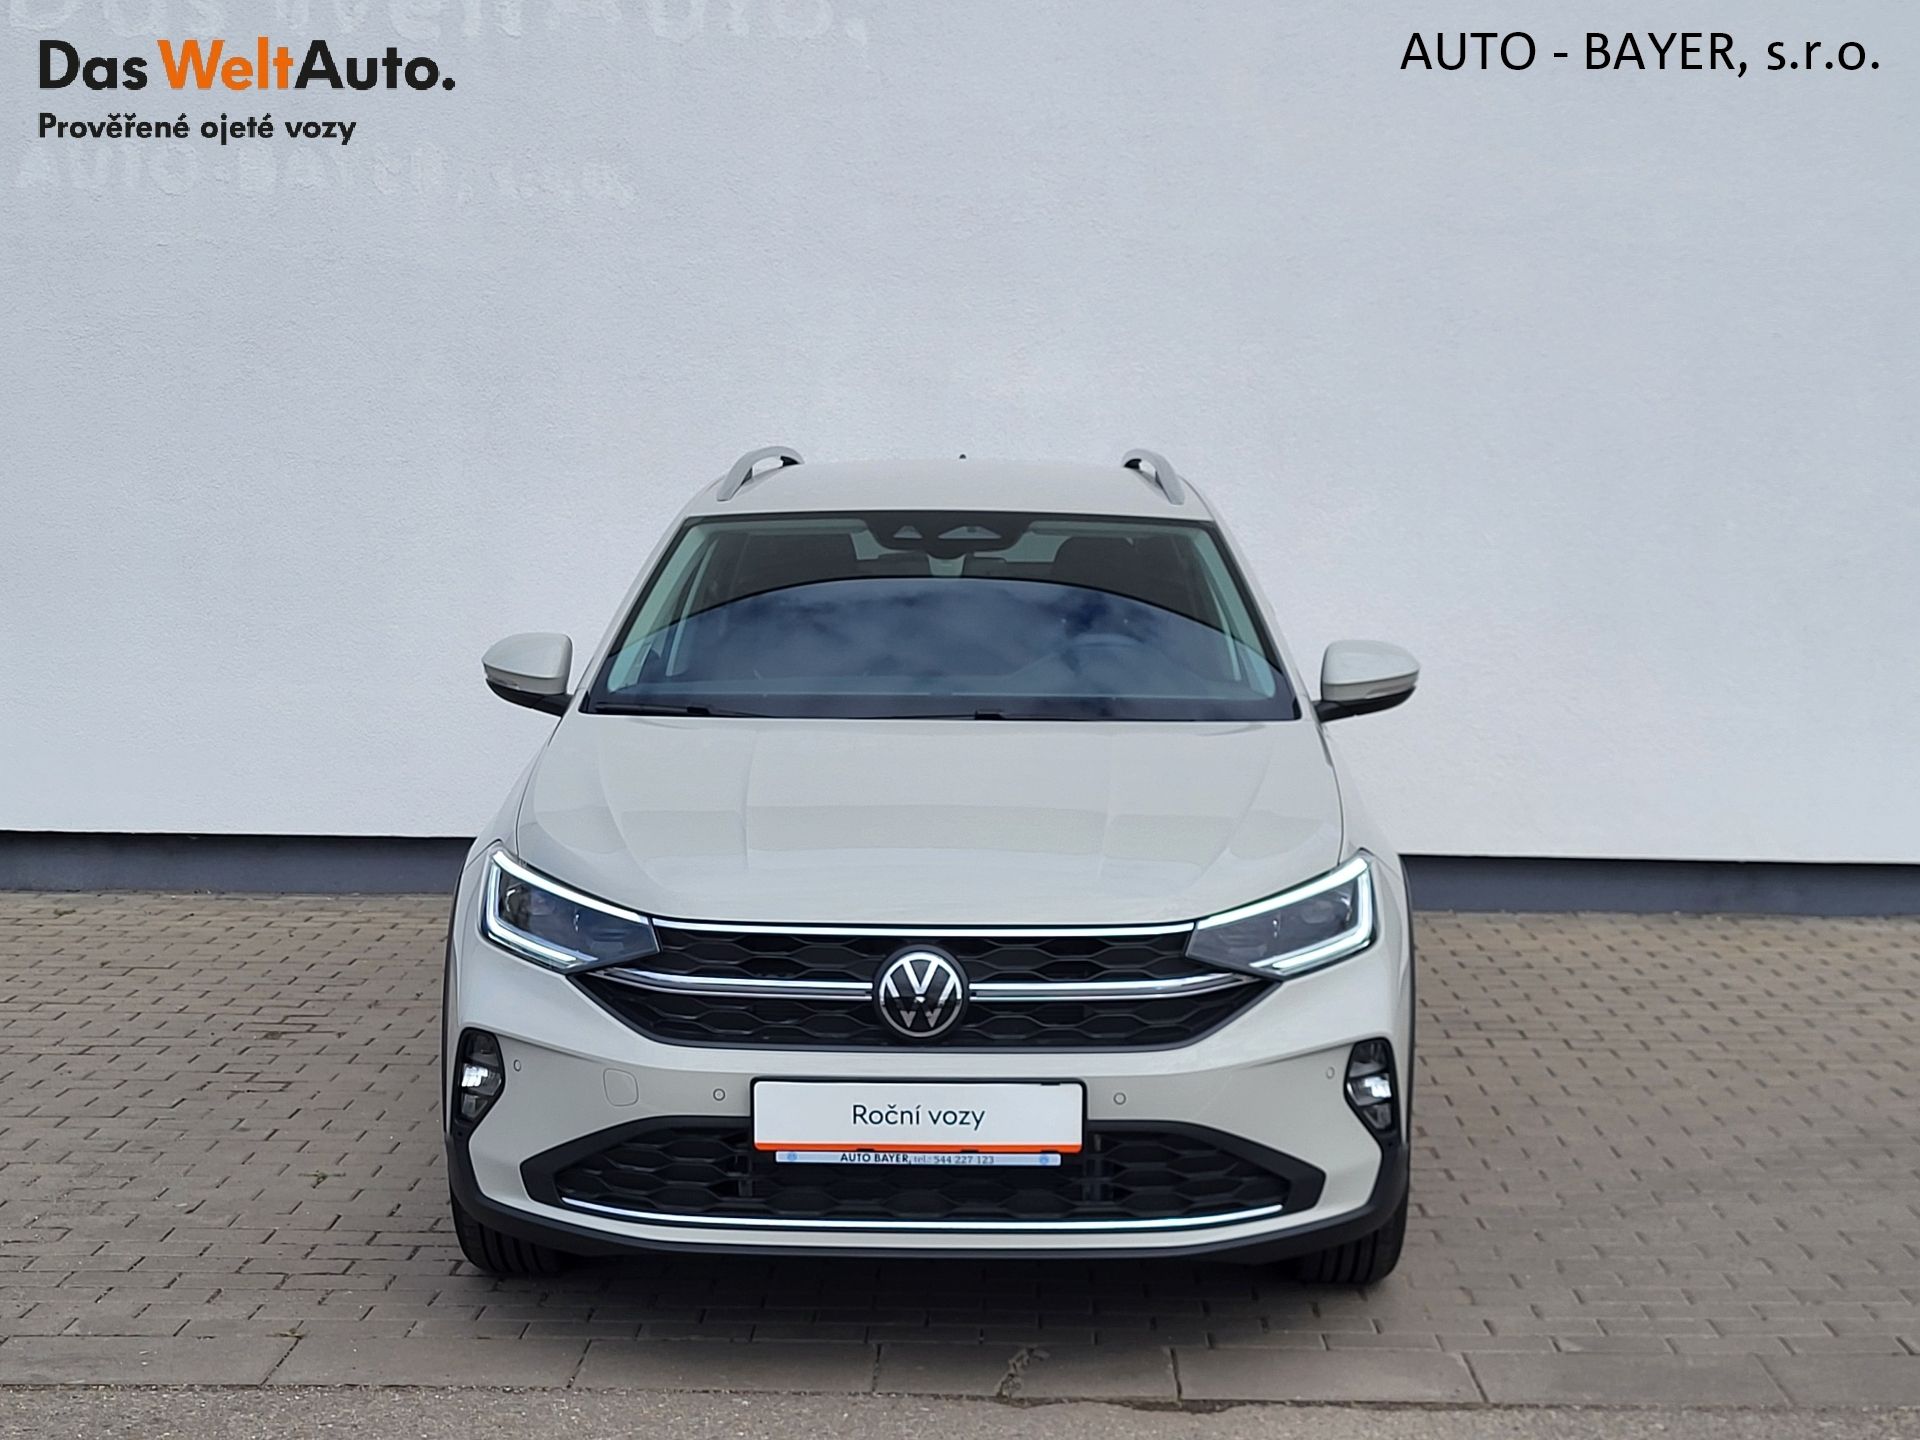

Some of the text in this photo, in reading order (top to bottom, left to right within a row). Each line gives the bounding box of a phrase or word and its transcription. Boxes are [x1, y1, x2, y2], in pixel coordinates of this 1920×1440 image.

[852, 1103, 986, 1132] Roční vozy
[840, 1152, 871, 1163] AUTO
[933, 1156, 952, 1165] 544
[954, 1156, 974, 1166] 227
[976, 1156, 995, 1166] 123
